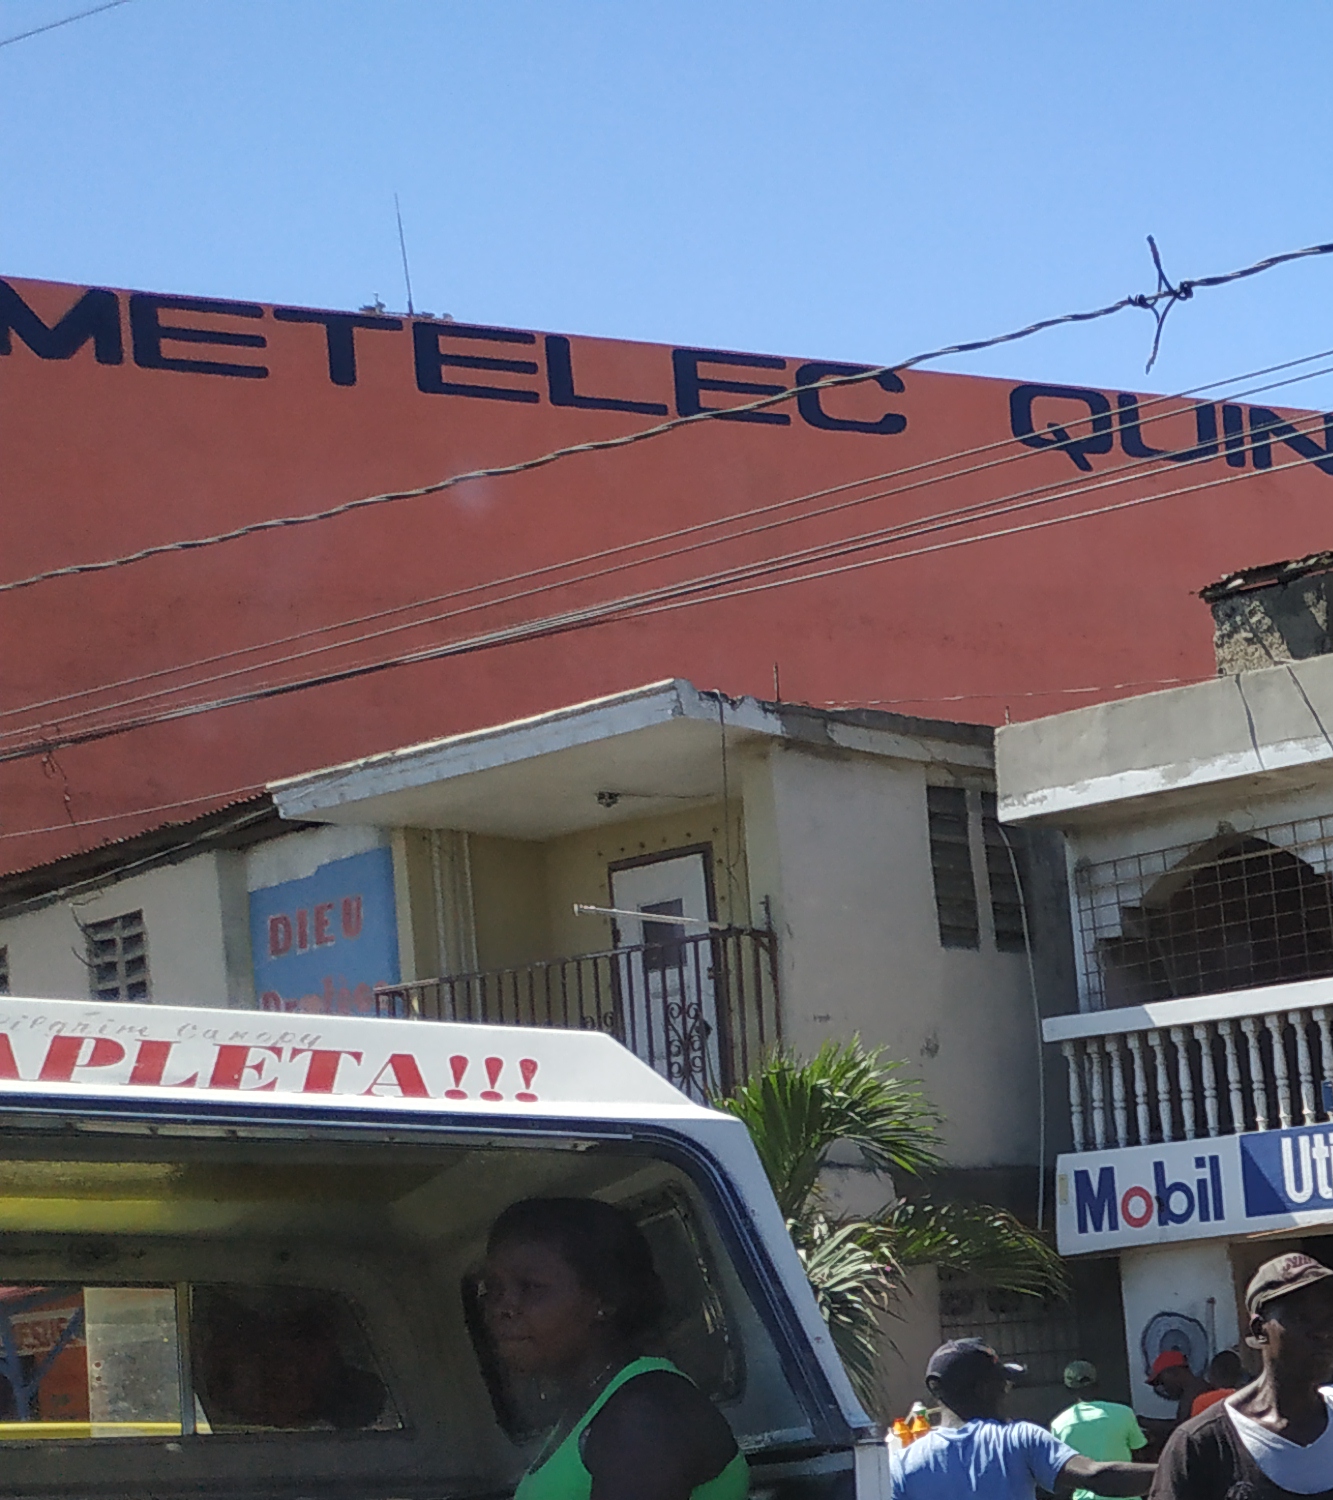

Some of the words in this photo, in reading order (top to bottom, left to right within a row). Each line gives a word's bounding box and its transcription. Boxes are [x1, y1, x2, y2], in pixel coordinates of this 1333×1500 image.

[0, 278, 907, 435] METELEC
[268, 895, 364, 960] DIEU
[1073, 1154, 1225, 1235] Mobil
